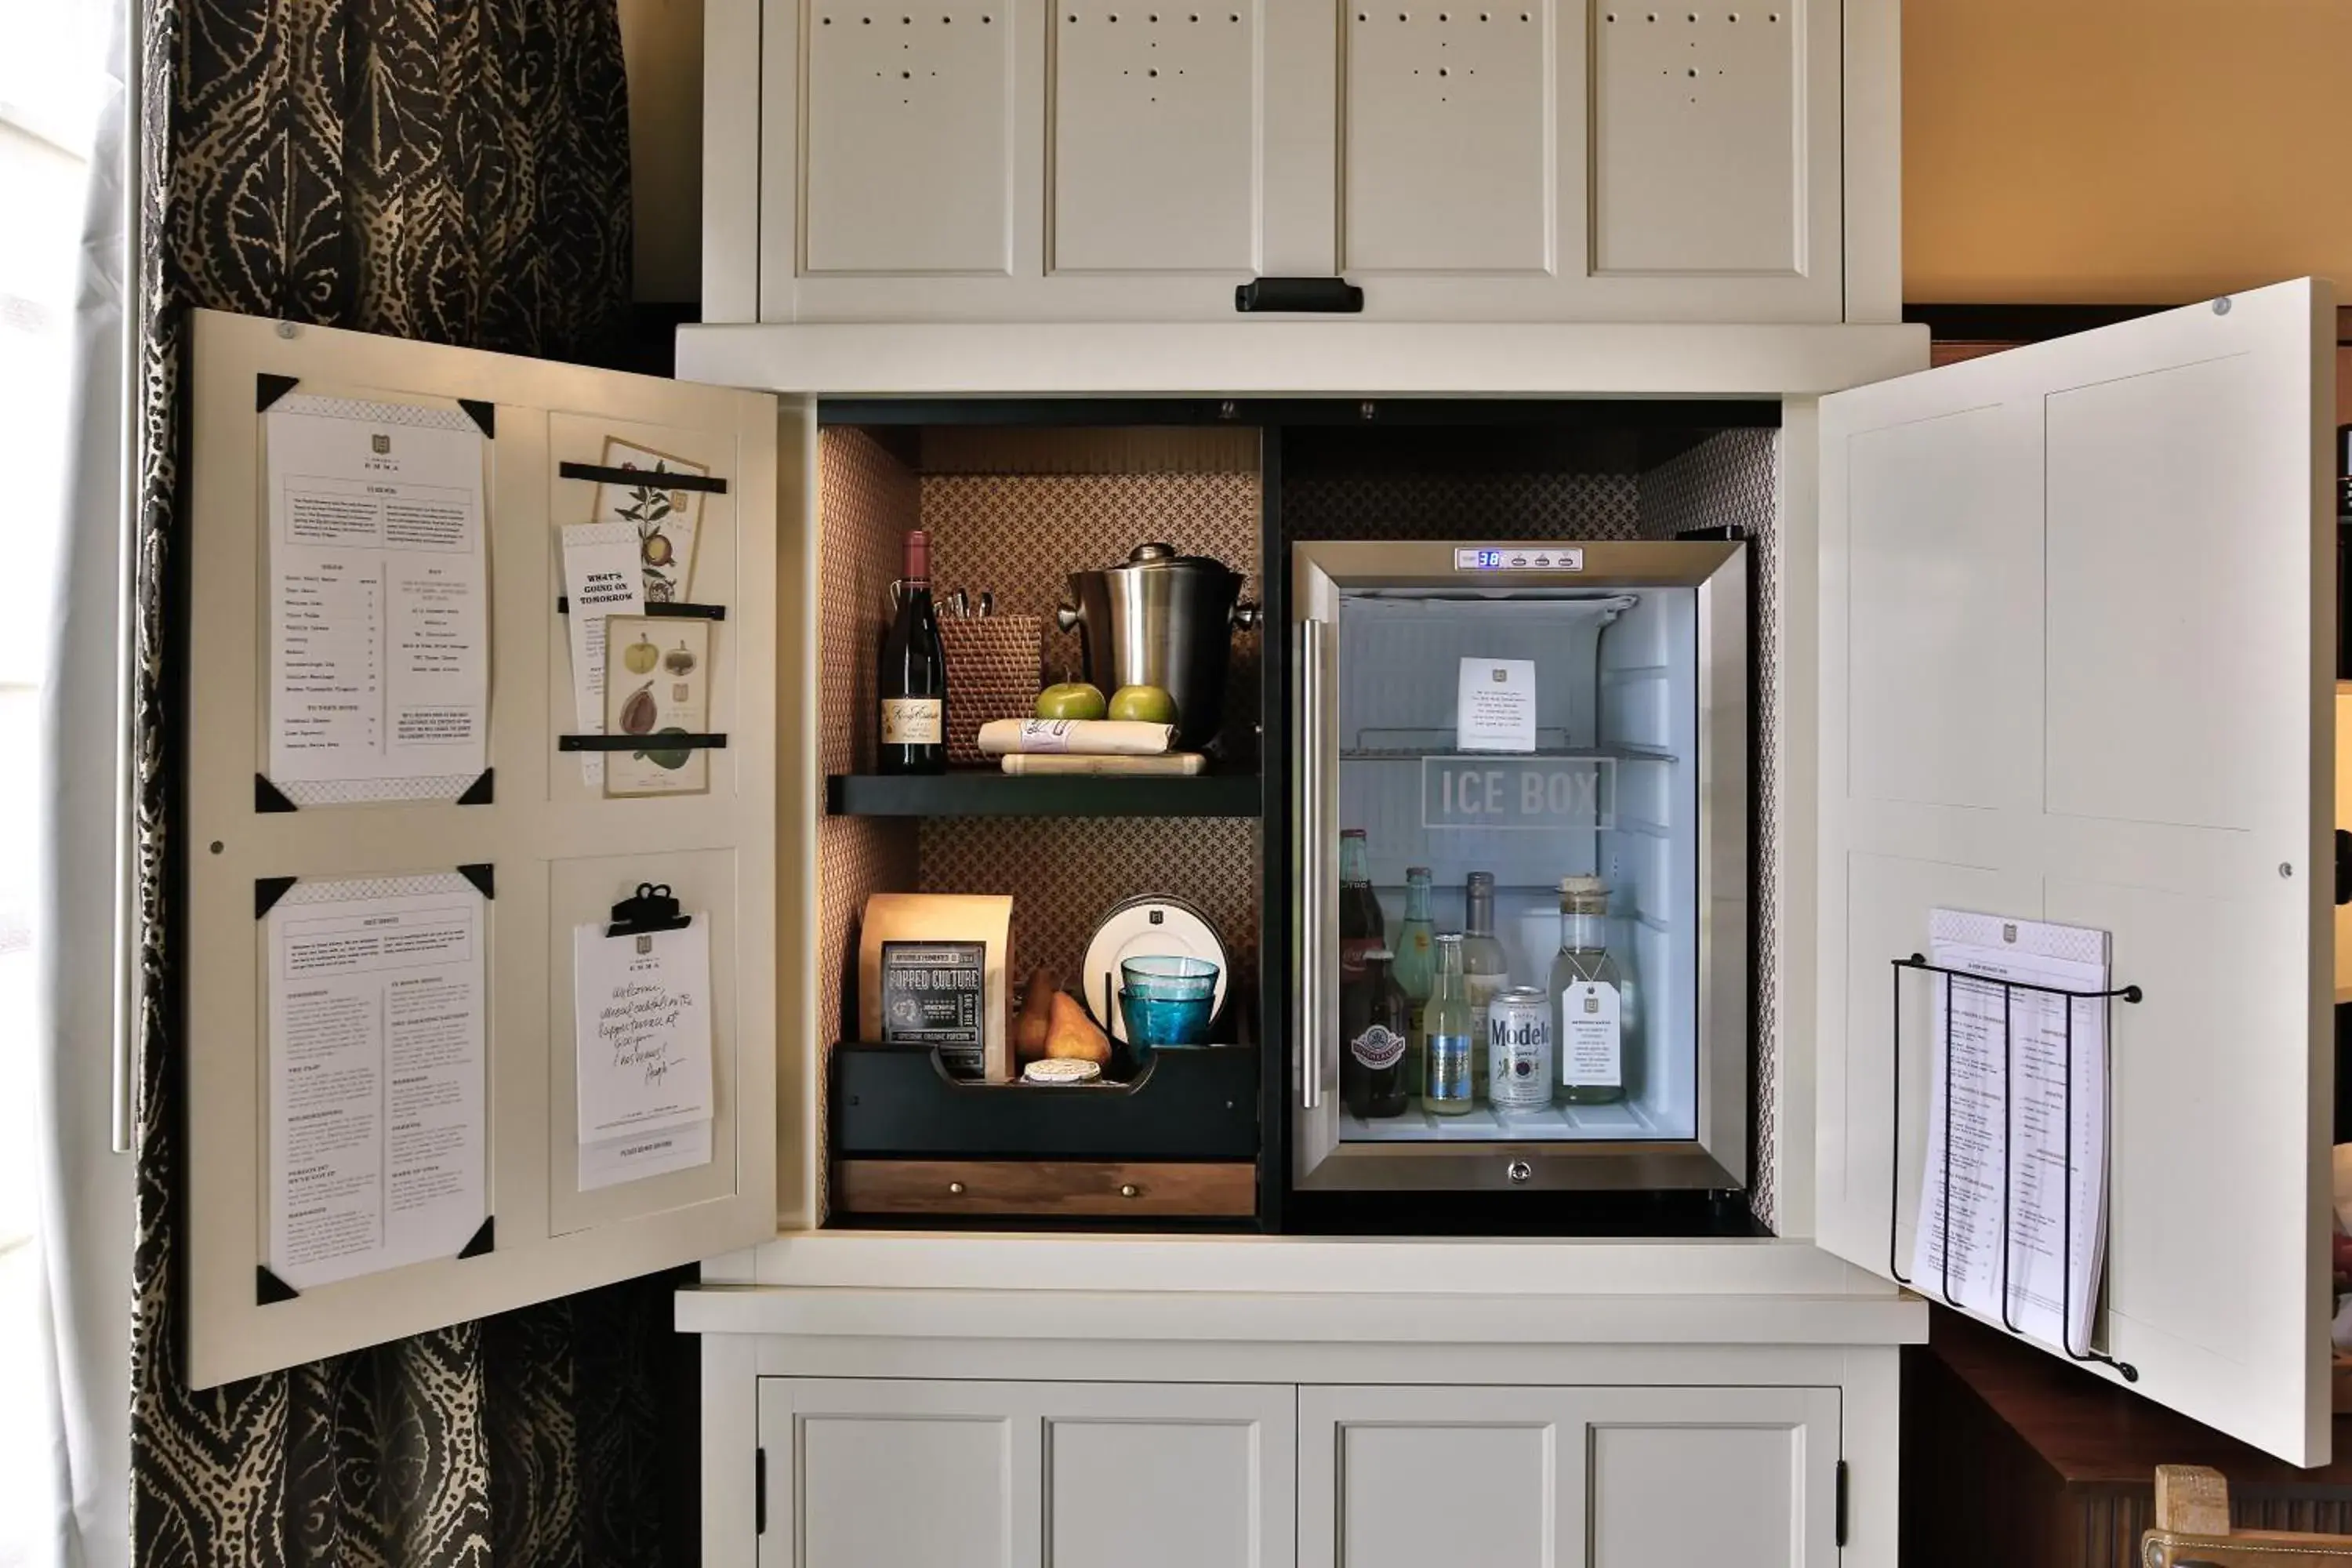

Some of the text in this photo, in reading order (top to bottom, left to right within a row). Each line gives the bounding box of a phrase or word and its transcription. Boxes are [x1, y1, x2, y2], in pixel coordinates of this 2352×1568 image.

[1479, 553, 1499, 565] 38
[584, 584, 612, 593] GOING
[580, 592, 632, 604] TOMORROW
[1443, 771, 1599, 815] ICE BOX
[890, 970, 979, 988] POPPED CULTURE
